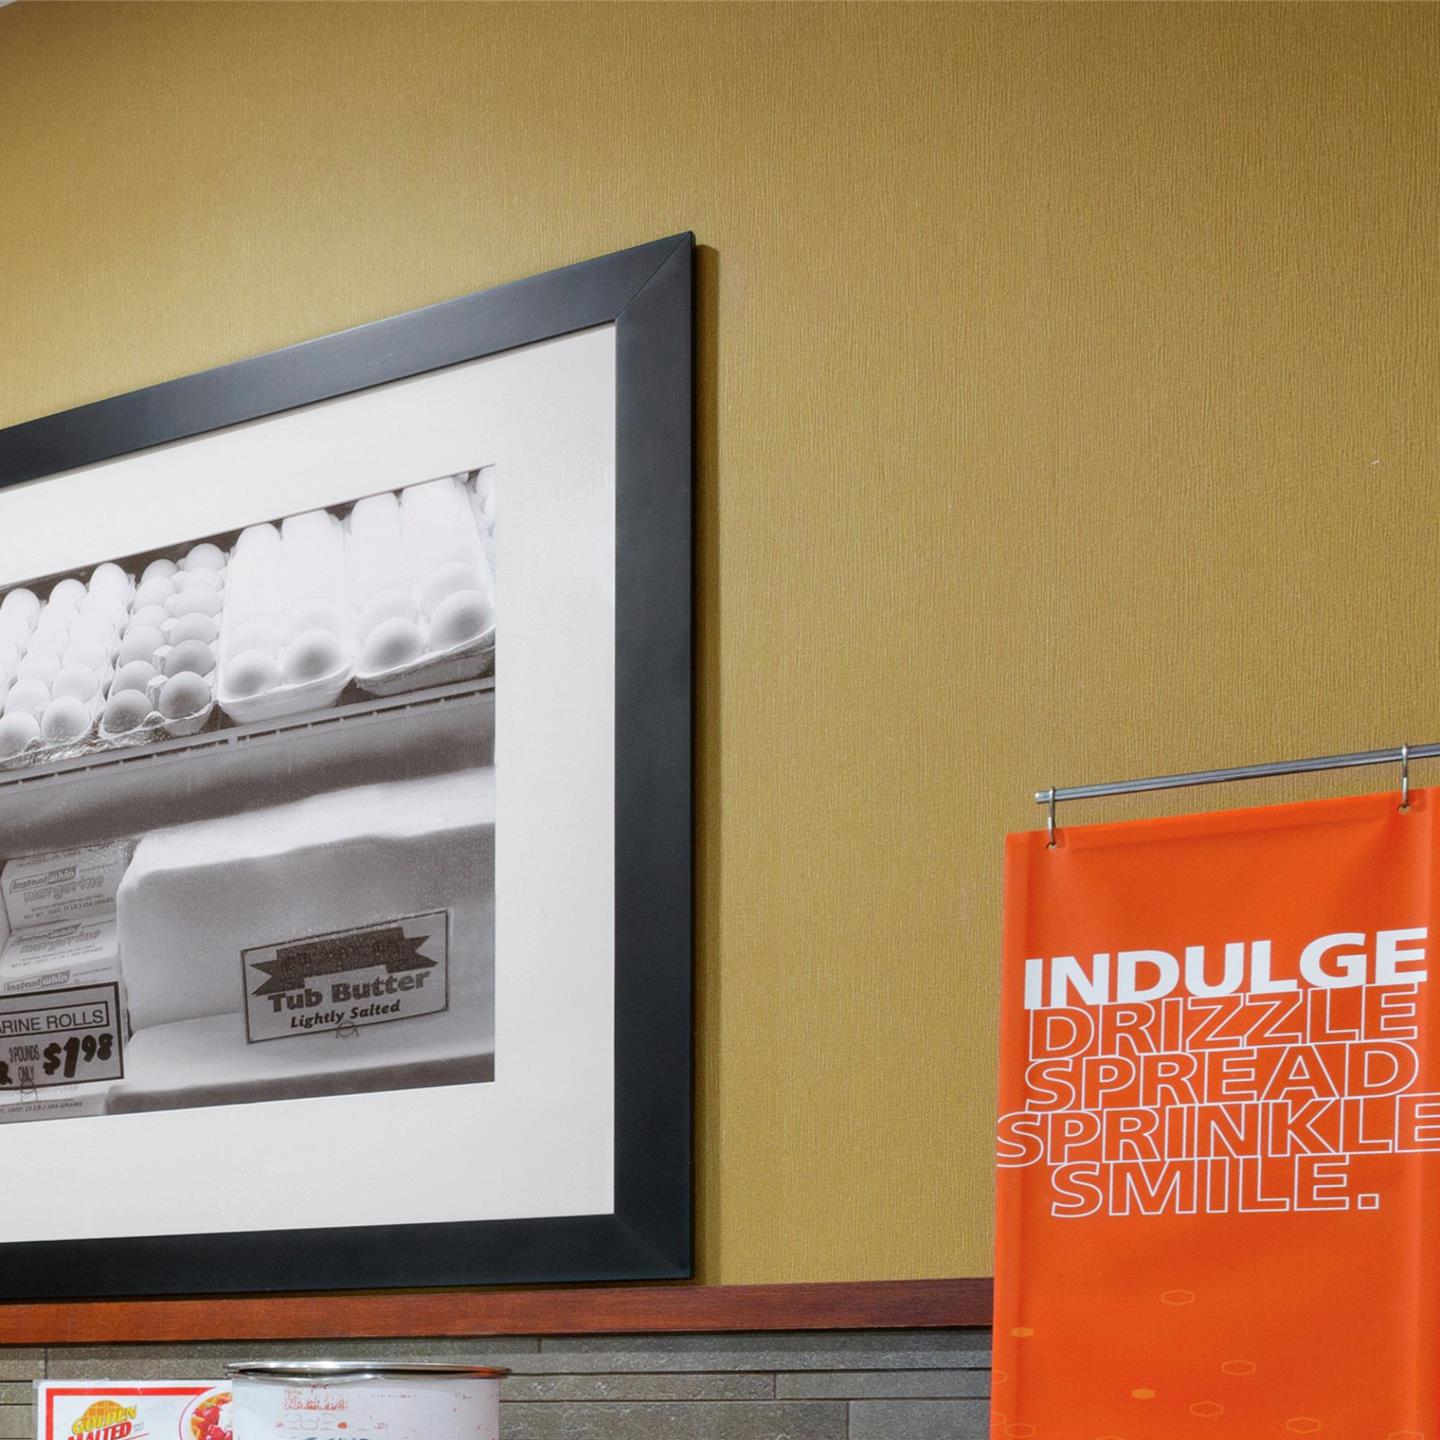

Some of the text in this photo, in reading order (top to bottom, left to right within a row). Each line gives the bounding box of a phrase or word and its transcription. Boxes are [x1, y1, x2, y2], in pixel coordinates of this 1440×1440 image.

[267, 971, 431, 1013] Tub Butter
[1024, 926, 1428, 1010] INDULGE
[46, 1009, 104, 1029] ROLLS
[290, 1000, 401, 1029] Lightly Salted
[1029, 980, 1419, 1062] DRIZZLE
[1024, 1039, 1419, 1113] SPREAD
[996, 1092, 1440, 1168] SPRINKLE
[1051, 1153, 1380, 1218] SMILE.
[71, 1405, 138, 1436] GOLDEN
